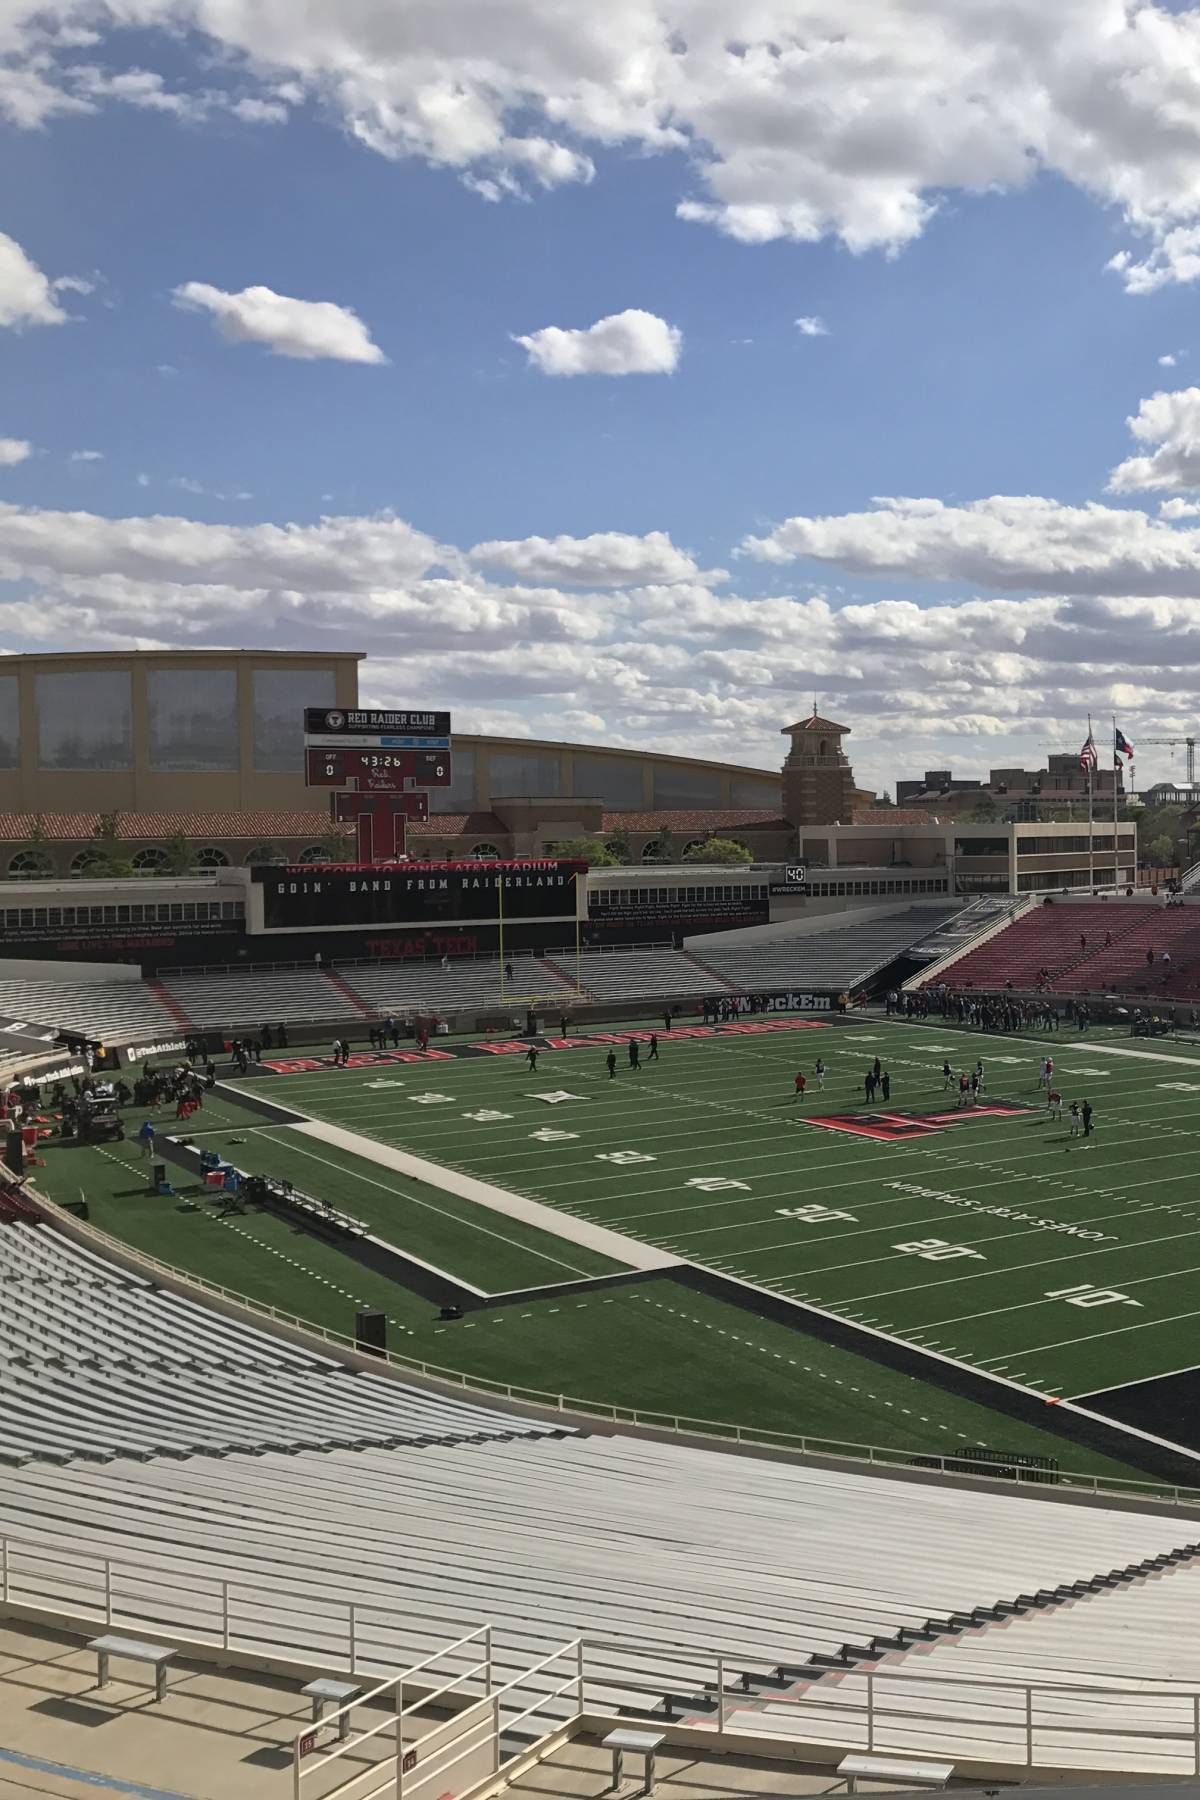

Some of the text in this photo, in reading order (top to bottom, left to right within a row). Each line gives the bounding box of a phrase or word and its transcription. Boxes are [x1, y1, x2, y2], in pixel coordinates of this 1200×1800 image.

[348, 712, 435, 726] RED RAIDER CLUB
[361, 756, 401, 767] 43:26
[326, 764, 444, 777] 0 0
[495, 861, 559, 872] STADIUM
[787, 868, 804, 881] 40
[350, 880, 391, 892] BAND
[406, 878, 448, 890] FROM
[462, 876, 565, 889] RAIDERLAND
[367, 938, 424, 954] TEXAS
[718, 993, 832, 1014] #WeckEm
[259, 1048, 457, 1073] RED
[594, 1151, 657, 1165] 50
[684, 1177, 747, 1191] 40
[883, 1181, 979, 1207] STADIUM
[775, 1204, 852, 1223] 30
[1031, 1219, 1118, 1241] JONES
[891, 1238, 977, 1261] 20
[1043, 1284, 1130, 1308] 10
[304, 1738, 313, 1750] 15
